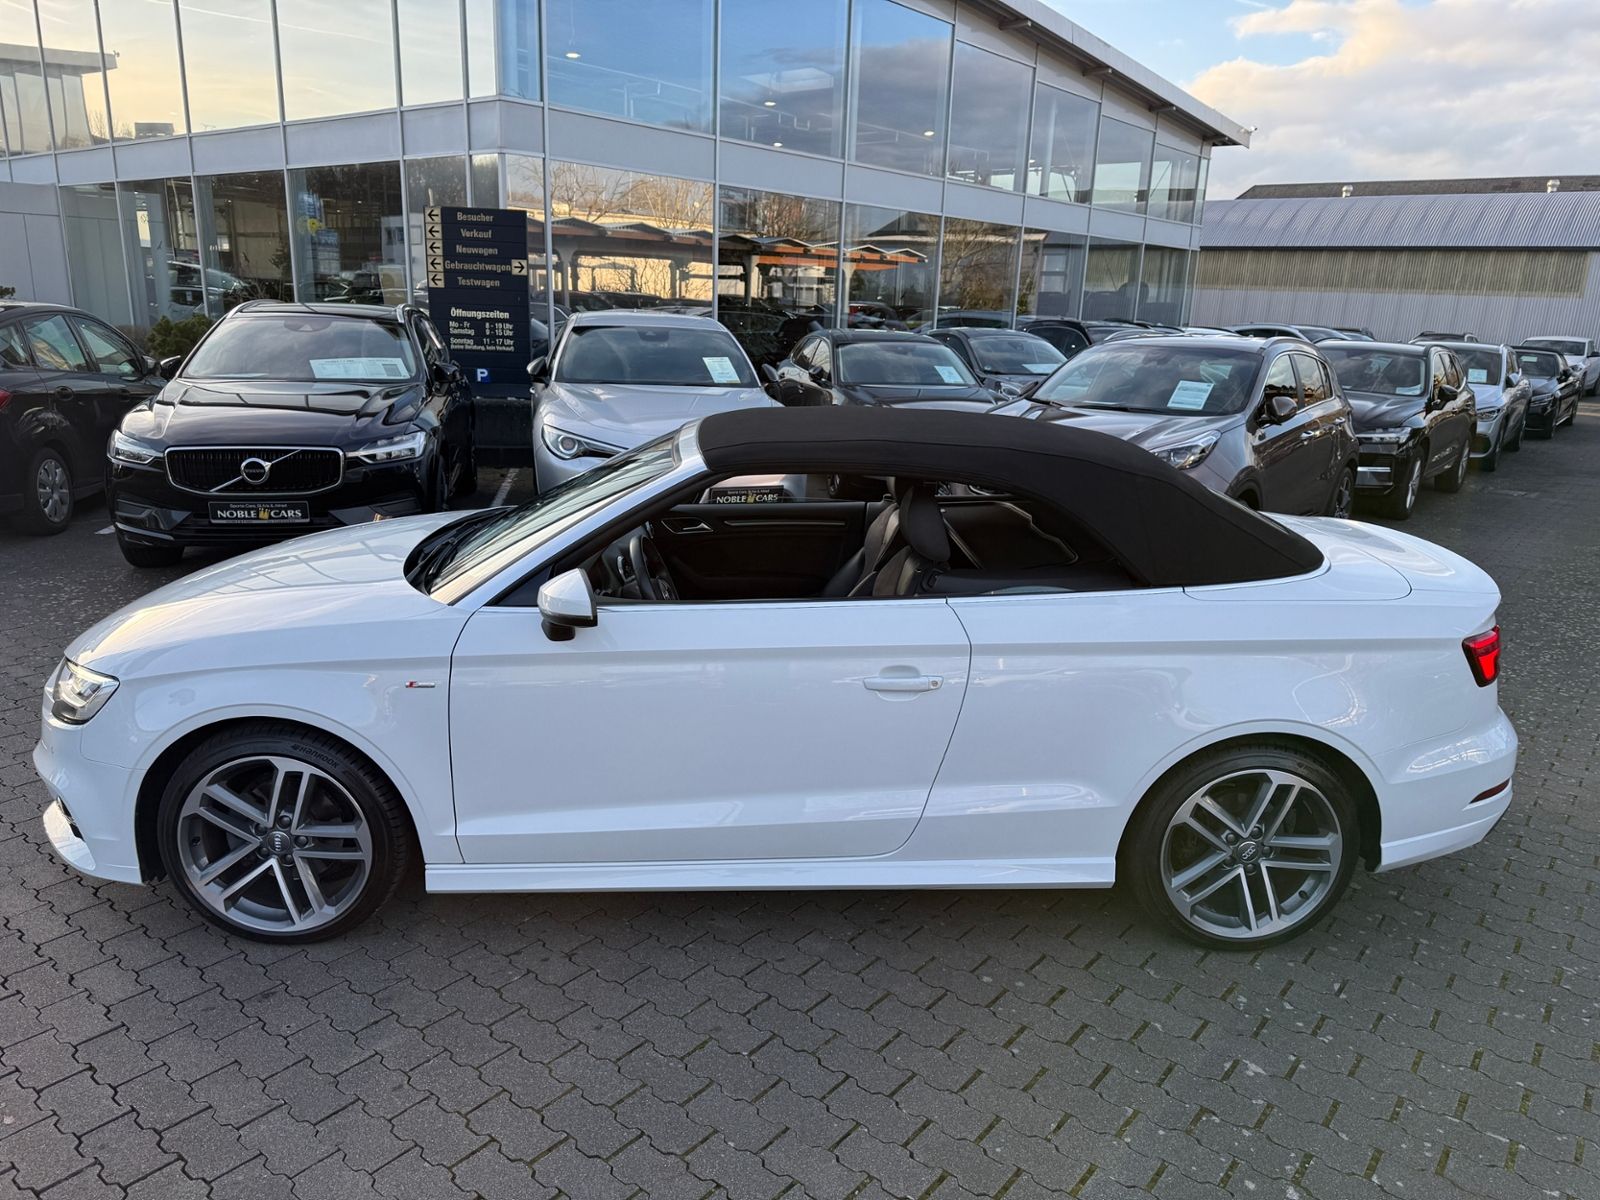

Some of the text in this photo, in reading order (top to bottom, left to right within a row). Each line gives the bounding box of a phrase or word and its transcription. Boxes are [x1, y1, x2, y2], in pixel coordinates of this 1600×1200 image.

[457, 212, 494, 221] Besucher
[460, 228, 492, 238] Verkauf
[456, 244, 498, 256] Neuwagen
[444, 261, 511, 273] Gebrauchtwagen
[457, 276, 500, 288] Testwagen
[450, 307, 510, 319] Öffnungszeiten
[450, 338, 474, 346] Sonntag
[477, 368, 488, 382] P
[716, 493, 778, 504] NOBLE CARS
[217, 509, 302, 518] NOBLE CARS
